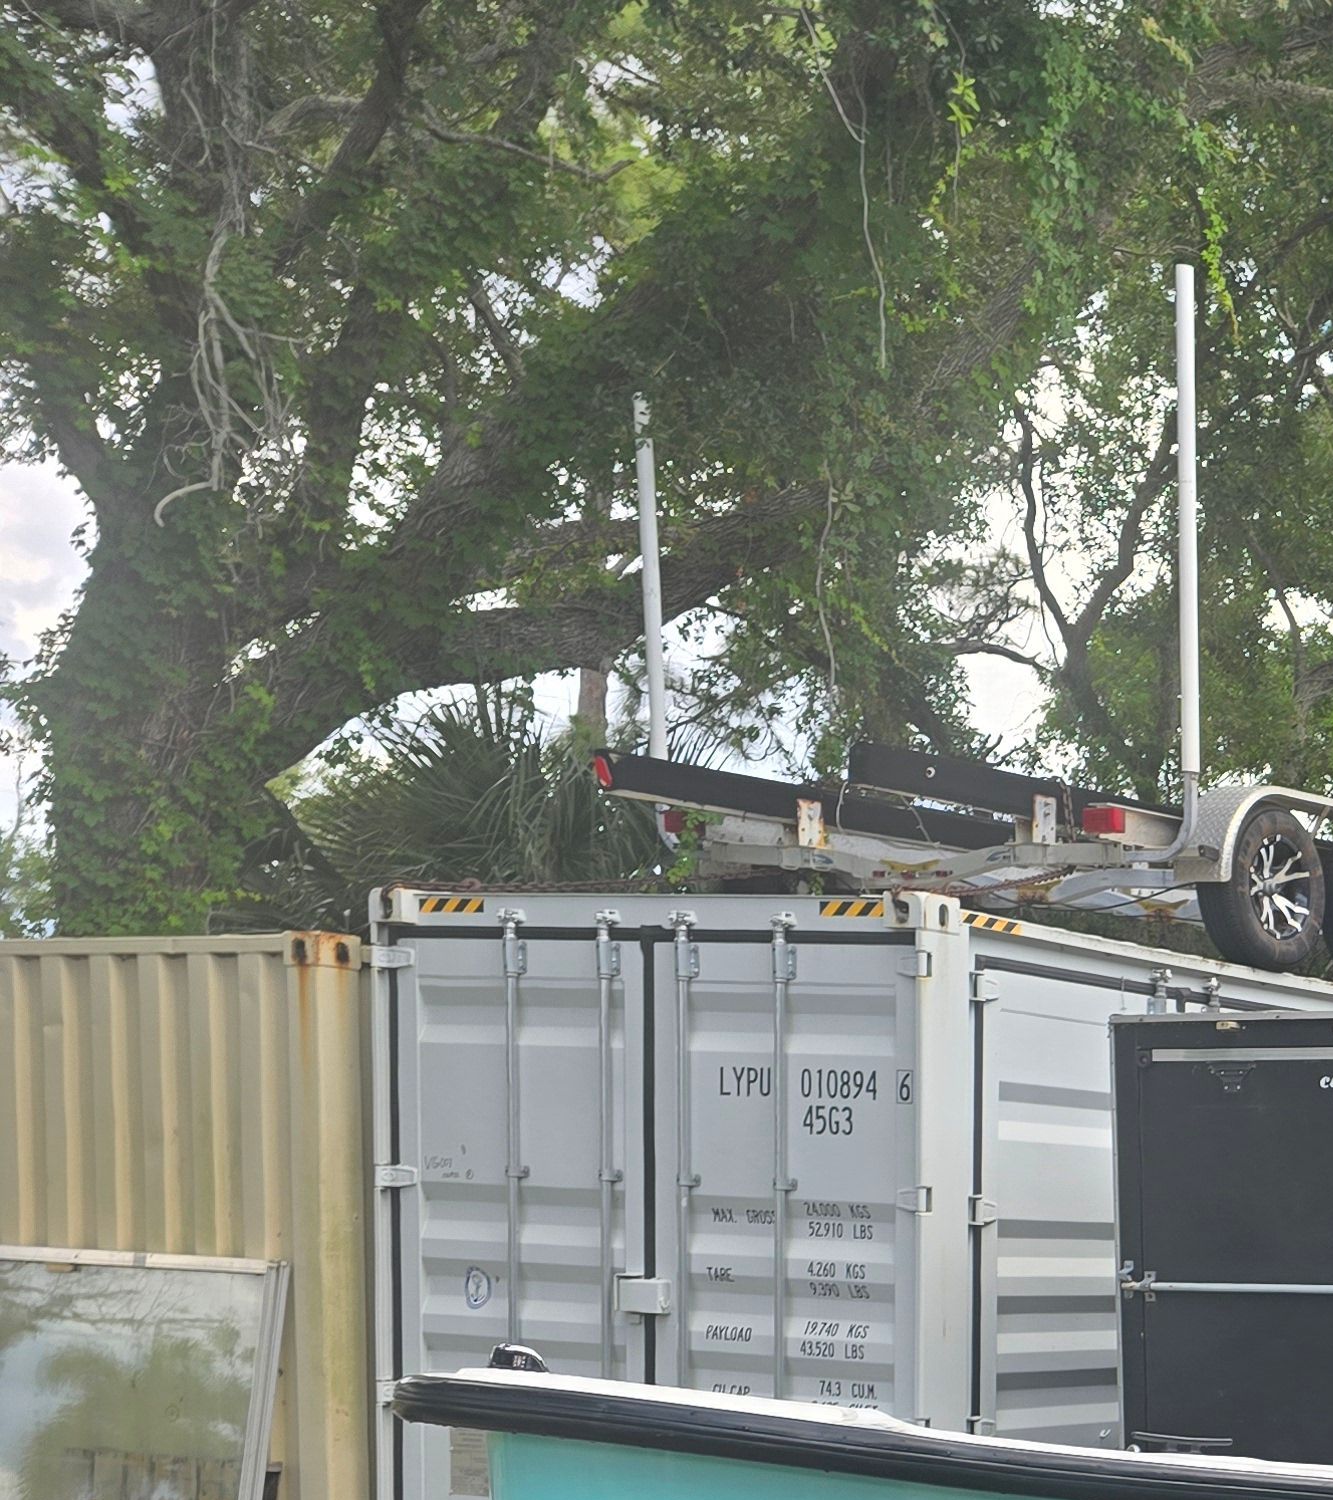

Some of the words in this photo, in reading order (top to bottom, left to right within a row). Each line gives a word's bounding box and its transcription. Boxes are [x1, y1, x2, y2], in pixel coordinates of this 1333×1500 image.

[720, 1067, 771, 1097] LYPU
[801, 1068, 877, 1101] 010894
[899, 1072, 911, 1101] 6
[803, 1105, 854, 1135] 45G3
[711, 1208, 737, 1223] MAX.
[849, 1204, 872, 1219] KGS
[809, 1221, 843, 1238] 52.910
[853, 1224, 873, 1240] LBS
[706, 1266, 735, 1282] TARE
[807, 1262, 836, 1278] 4.260
[846, 1263, 866, 1279] KGS
[848, 1284, 871, 1299] LBS
[705, 1324, 752, 1342] PAYLOAD
[804, 1321, 840, 1337] 19.740
[846, 1324, 870, 1339] KGS
[800, 1341, 835, 1357] 43.520
[844, 1344, 865, 1360] LBS
[819, 1380, 841, 1397] 74.3
